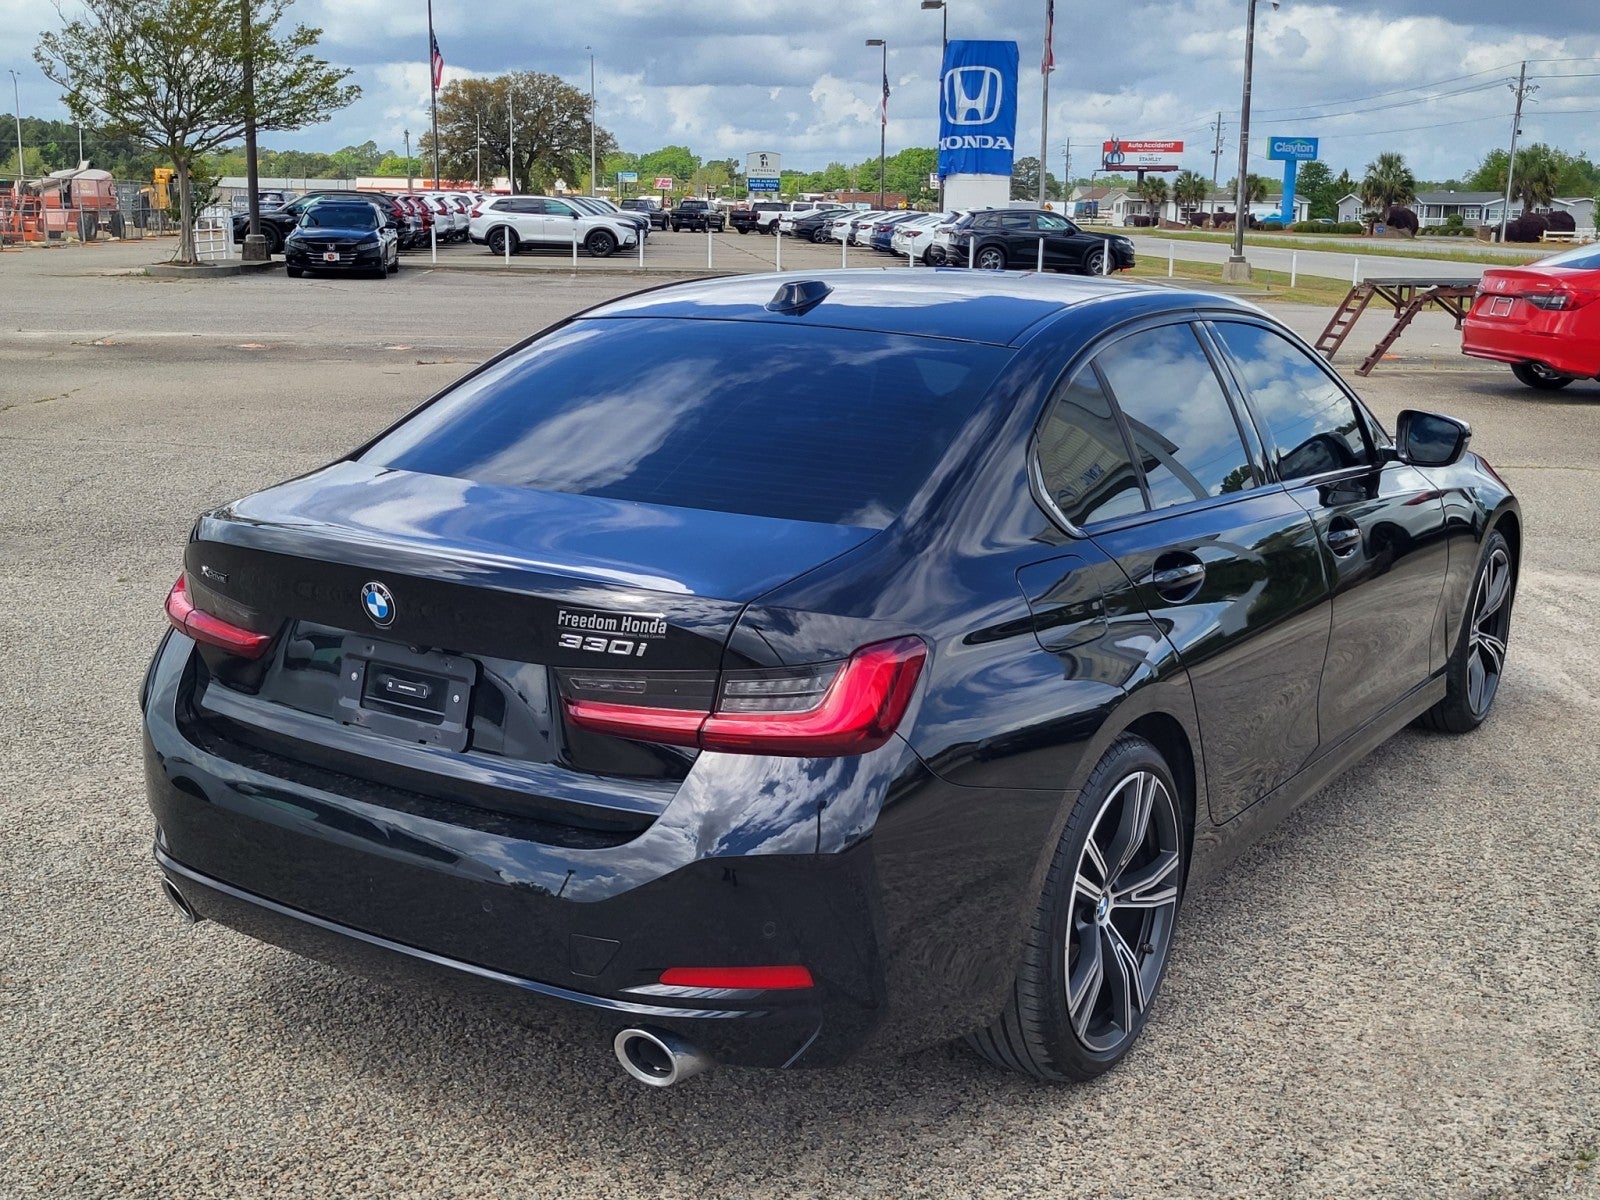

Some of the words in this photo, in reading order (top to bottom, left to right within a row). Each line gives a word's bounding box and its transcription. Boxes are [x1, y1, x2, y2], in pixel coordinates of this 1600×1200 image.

[939, 135, 1013, 150] HONDA
[1274, 142, 1314, 154] Clayton
[362, 584, 390, 600] BMW
[558, 611, 617, 631] Freedom
[621, 616, 667, 634] Honda
[558, 634, 647, 656] 330i
